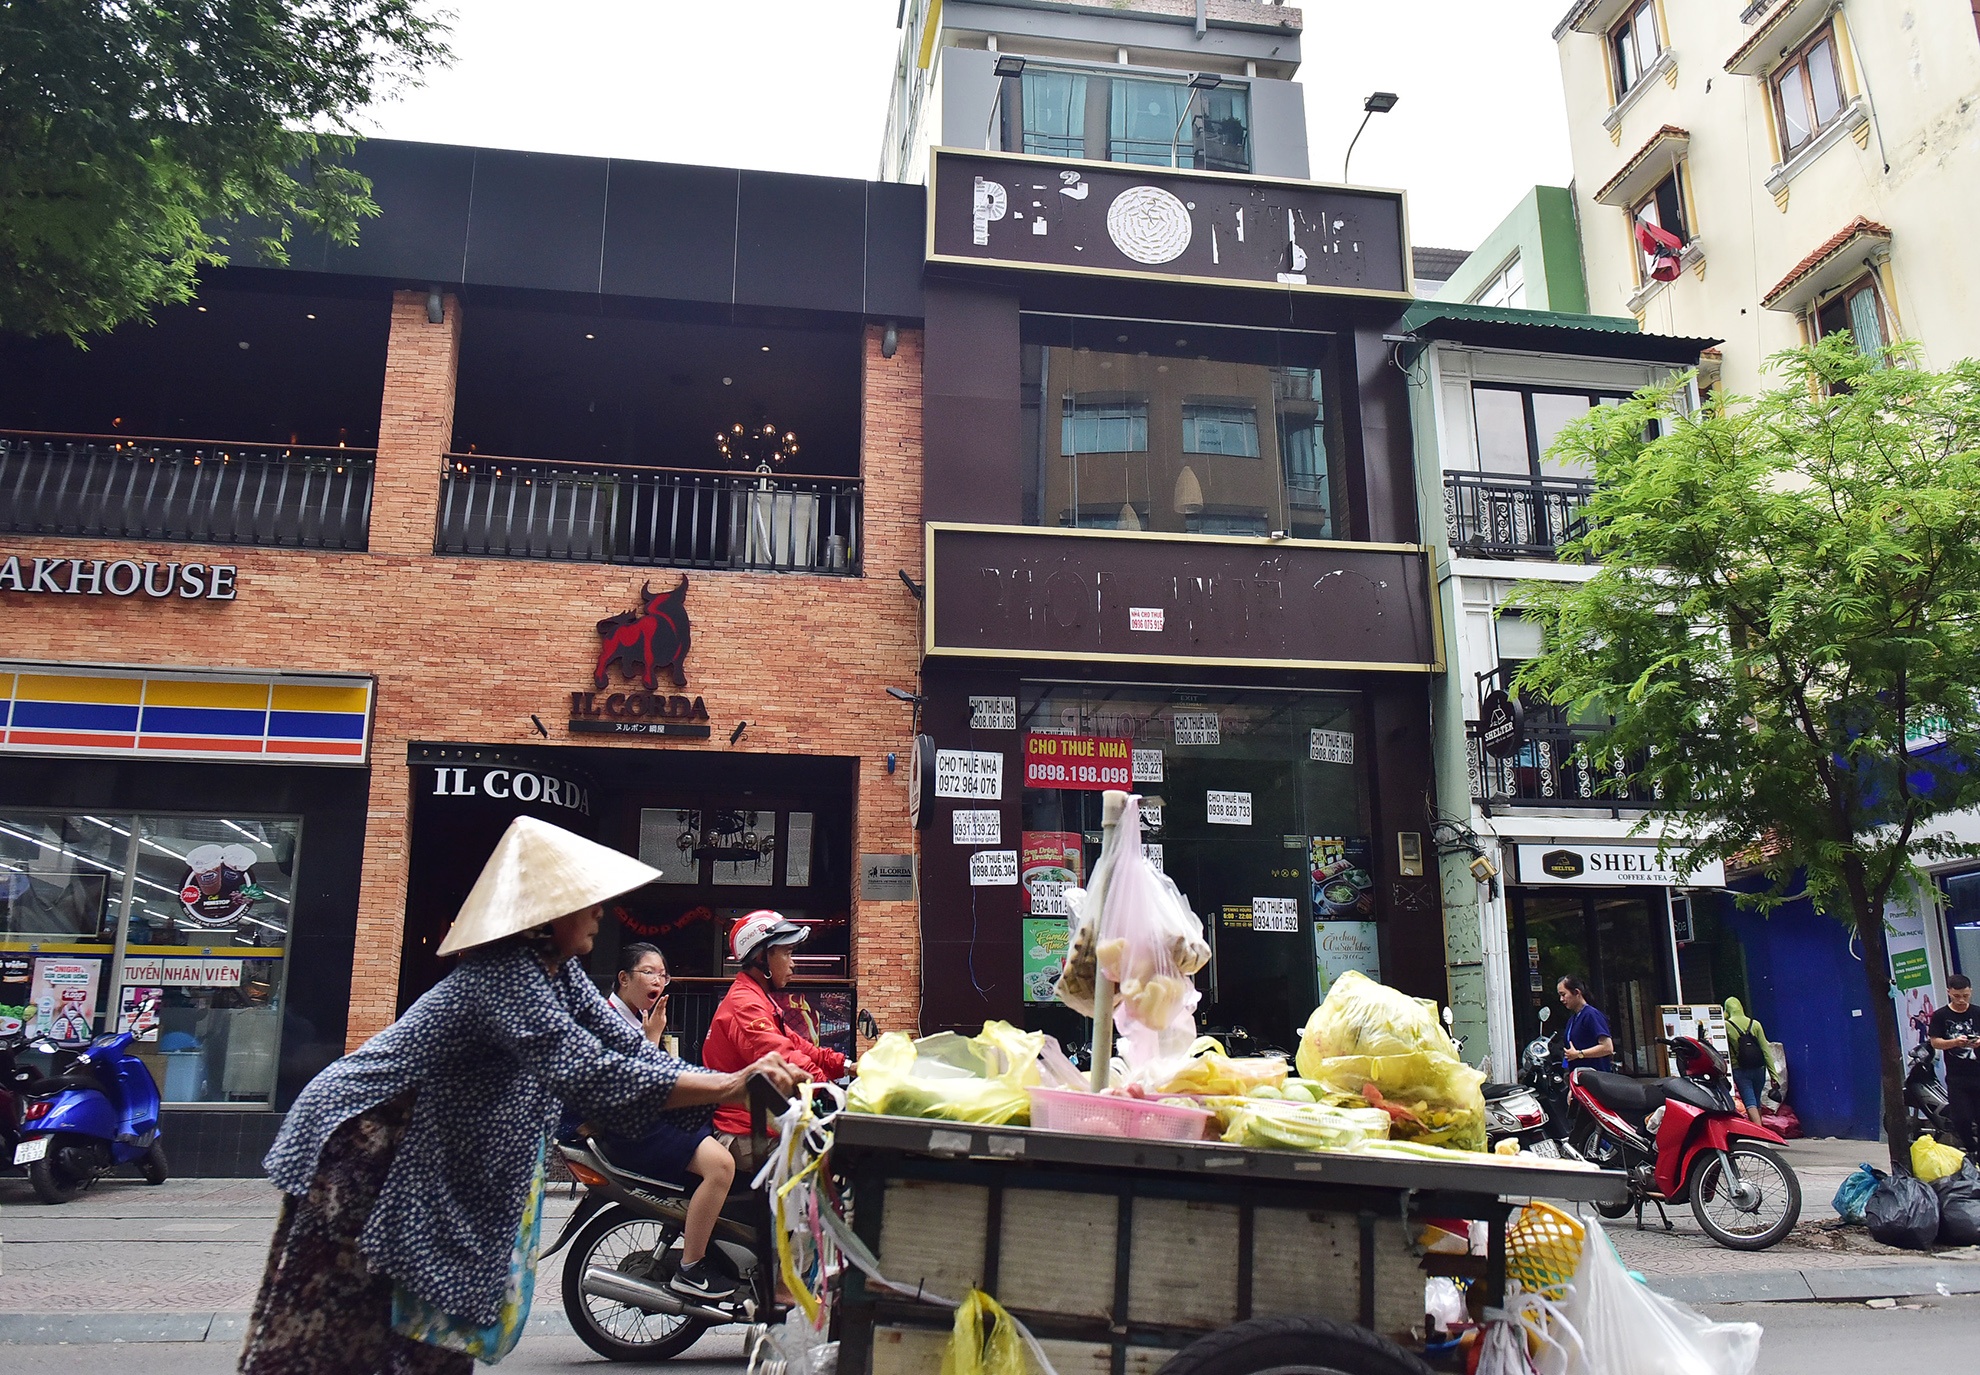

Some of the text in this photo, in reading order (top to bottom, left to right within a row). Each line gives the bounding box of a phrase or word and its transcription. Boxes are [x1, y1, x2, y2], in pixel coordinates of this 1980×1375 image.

[571, 691, 710, 721] IL CORDA
[984, 697, 1001, 714] THUÊ
[1001, 697, 1015, 714] NHÀ
[970, 715, 1015, 728] 0908.061.068
[1175, 717, 1188, 730] CHO
[1188, 714, 1205, 730] THUÊ
[1205, 714, 1218, 730] NHÀ
[1176, 732, 1219, 743] 0908.061.068
[1484, 721, 1514, 742] SHELTER
[1029, 738, 1057, 755] CHO
[1061, 738, 1095, 757] THUÊ
[1099, 740, 1128, 759] NHÀ
[1311, 731, 1353, 750] CHO THUÊ NHÀ
[1311, 746, 1353, 763] 0908.061.068
[938, 754, 998, 775] CHO THUÊ NHÀ
[1132, 763, 1162, 775] 1.339.227
[1028, 763, 1129, 784] 0898.198.098
[433, 768, 591, 817] IL CORDA
[938, 774, 997, 795] 0972 964 076
[1208, 793, 1251, 805] CHO THUÊ NHÀ
[1208, 804, 1224, 816] 0938
[1238, 806, 1251, 818] 733
[954, 823, 1000, 836] 0931.339.227
[970, 852, 1016, 864] CHO THUÊ NHÀ
[972, 865, 1017, 877] 0898.026.304
[1617, 873, 1646, 881] COFFEE
[1031, 884, 1046, 897] CHO
[1046, 882, 1063, 898] THUÊ
[1031, 899, 1068, 914] 0934.101.5
[1253, 898, 1297, 915] CHO THUÊ NHÀ
[1253, 915, 1297, 931] 0934.101.592
[125, 962, 240, 982] TUYỂN NHÂN VIÊN
